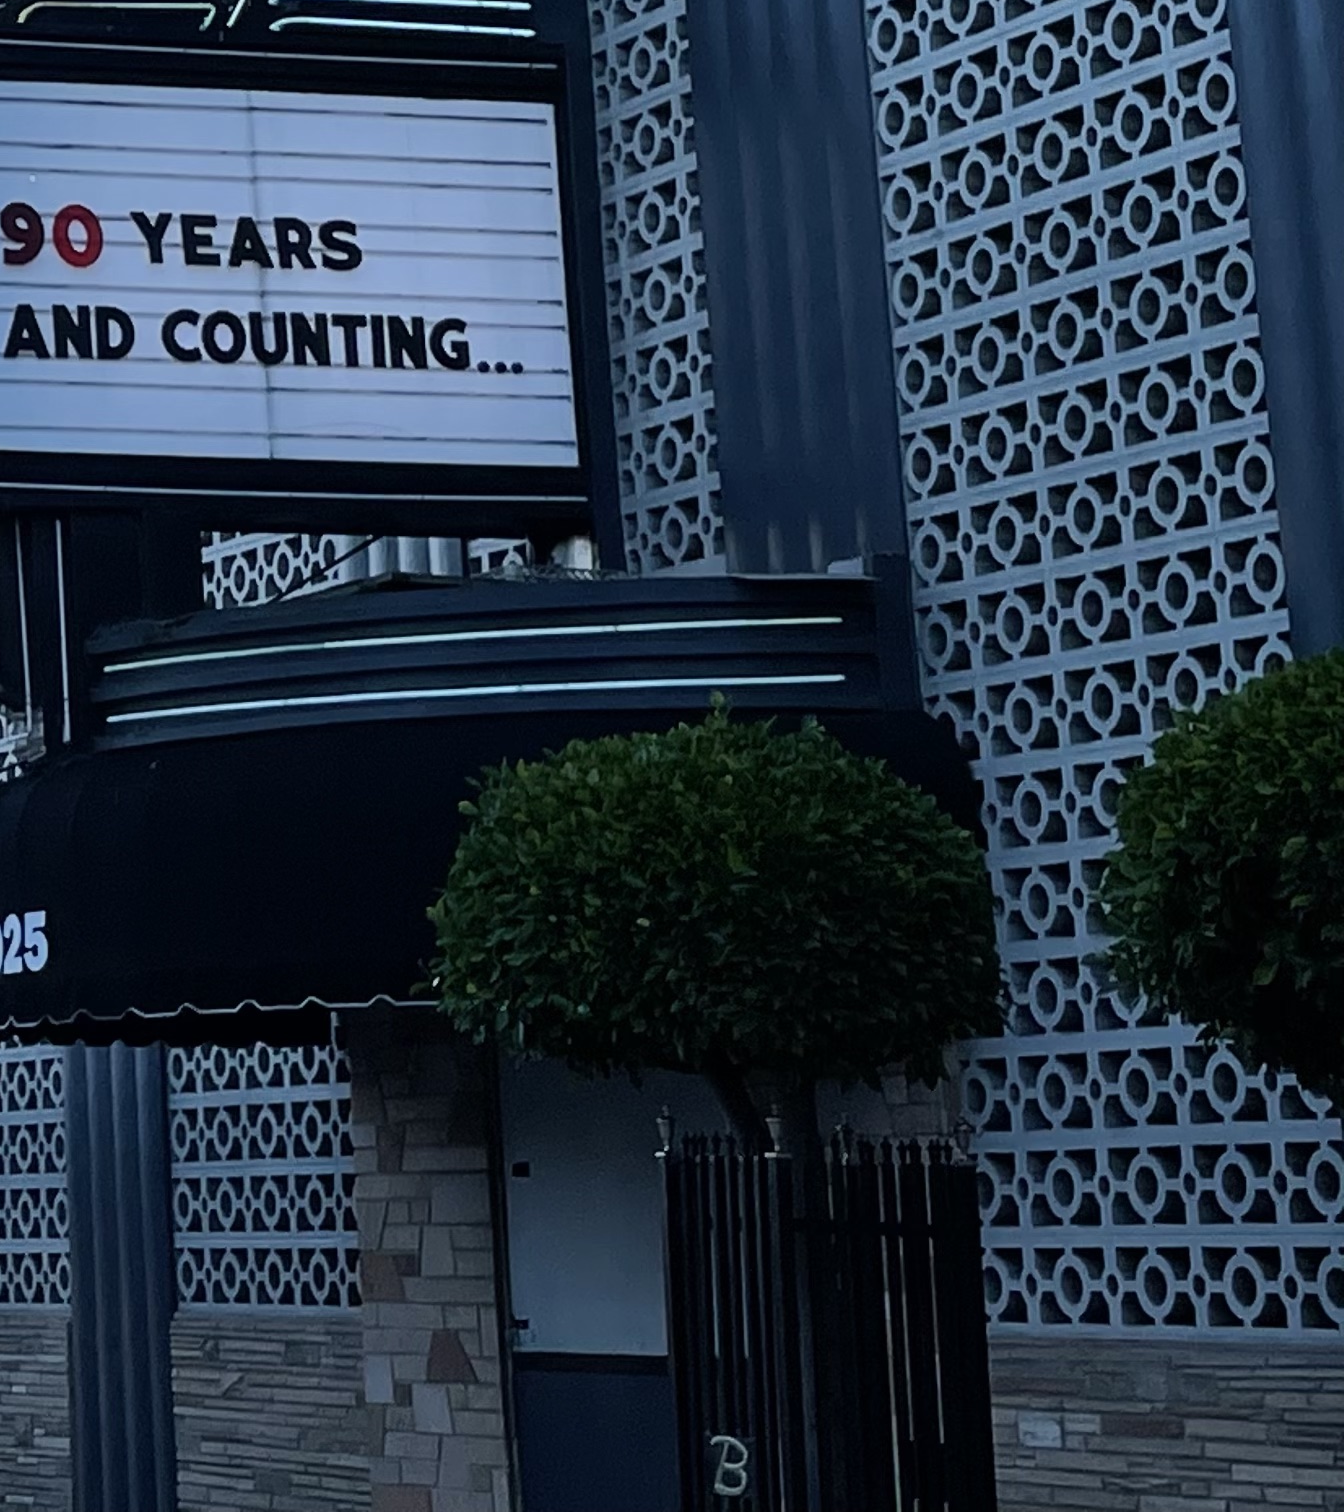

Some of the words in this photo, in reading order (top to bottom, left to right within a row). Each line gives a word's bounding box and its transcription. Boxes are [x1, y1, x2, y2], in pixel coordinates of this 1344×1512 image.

[130, 211, 363, 271] YEARS
[3, 303, 136, 361] AND
[161, 308, 524, 374] COUNTING...
